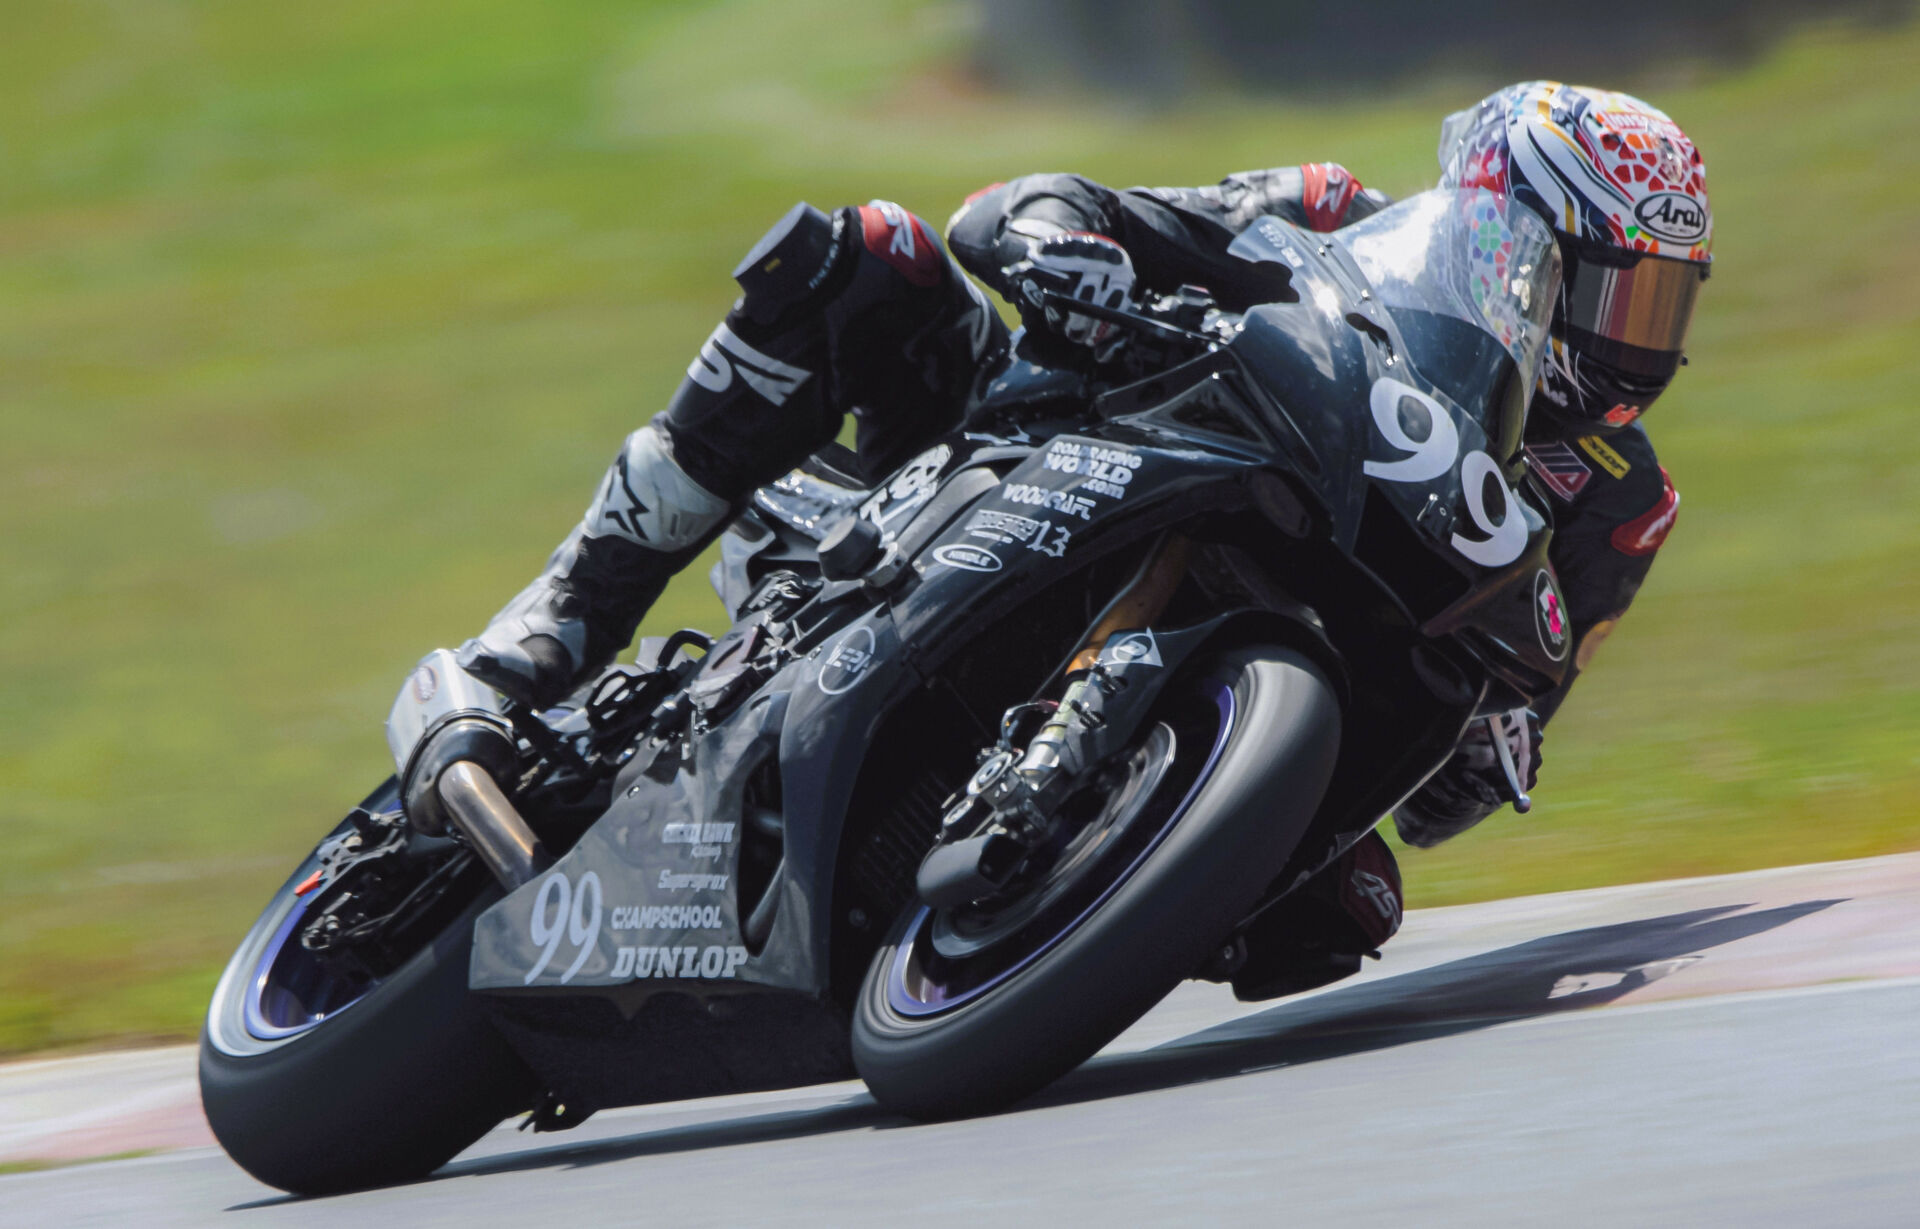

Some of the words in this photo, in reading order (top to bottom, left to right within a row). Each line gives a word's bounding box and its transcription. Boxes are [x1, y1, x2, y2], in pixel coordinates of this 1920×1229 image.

[1642, 197, 1701, 229] Arai
[1043, 452, 1133, 485] WORLD
[525, 871, 603, 985] 99
[610, 946, 749, 979] DUNLOP
